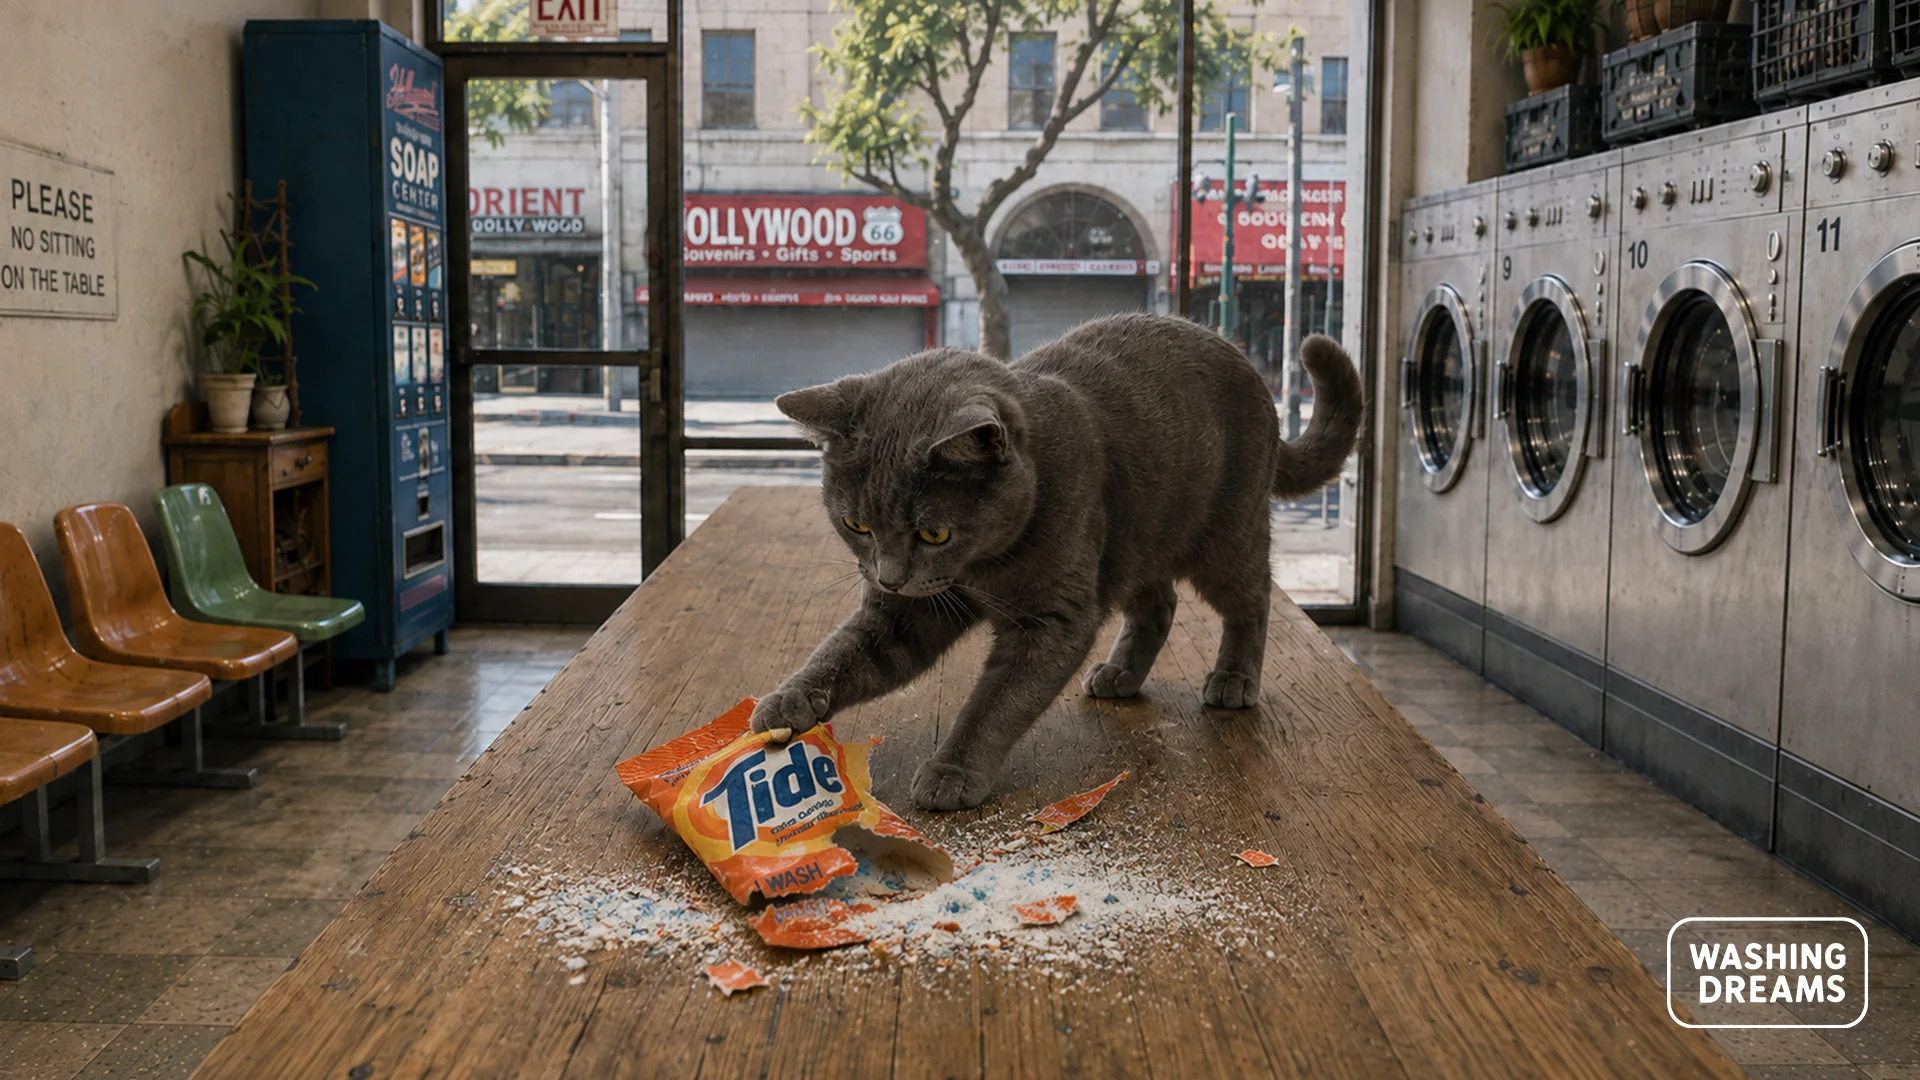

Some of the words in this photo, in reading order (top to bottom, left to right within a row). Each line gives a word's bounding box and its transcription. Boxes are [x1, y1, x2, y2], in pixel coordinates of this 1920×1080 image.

[390, 136, 439, 189] SOAP
[11, 178, 94, 223] PLEASE
[392, 180, 439, 212] CENTER
[11, 225, 35, 251] NO
[40, 229, 96, 260] SITTING
[684, 206, 857, 247] OLLYWOOD
[870, 224, 896, 241] 66
[1817, 216, 1841, 253] 11
[776, 246, 819, 263] Gifts
[840, 246, 897, 265] Sports
[1502, 255, 1512, 281] 9
[1627, 239, 1649, 269] 10
[1, 264, 25, 290] ON
[29, 267, 59, 293] THE
[62, 271, 106, 297] TABLE
[701, 740, 844, 850] Tide
[764, 860, 824, 893] WASH
